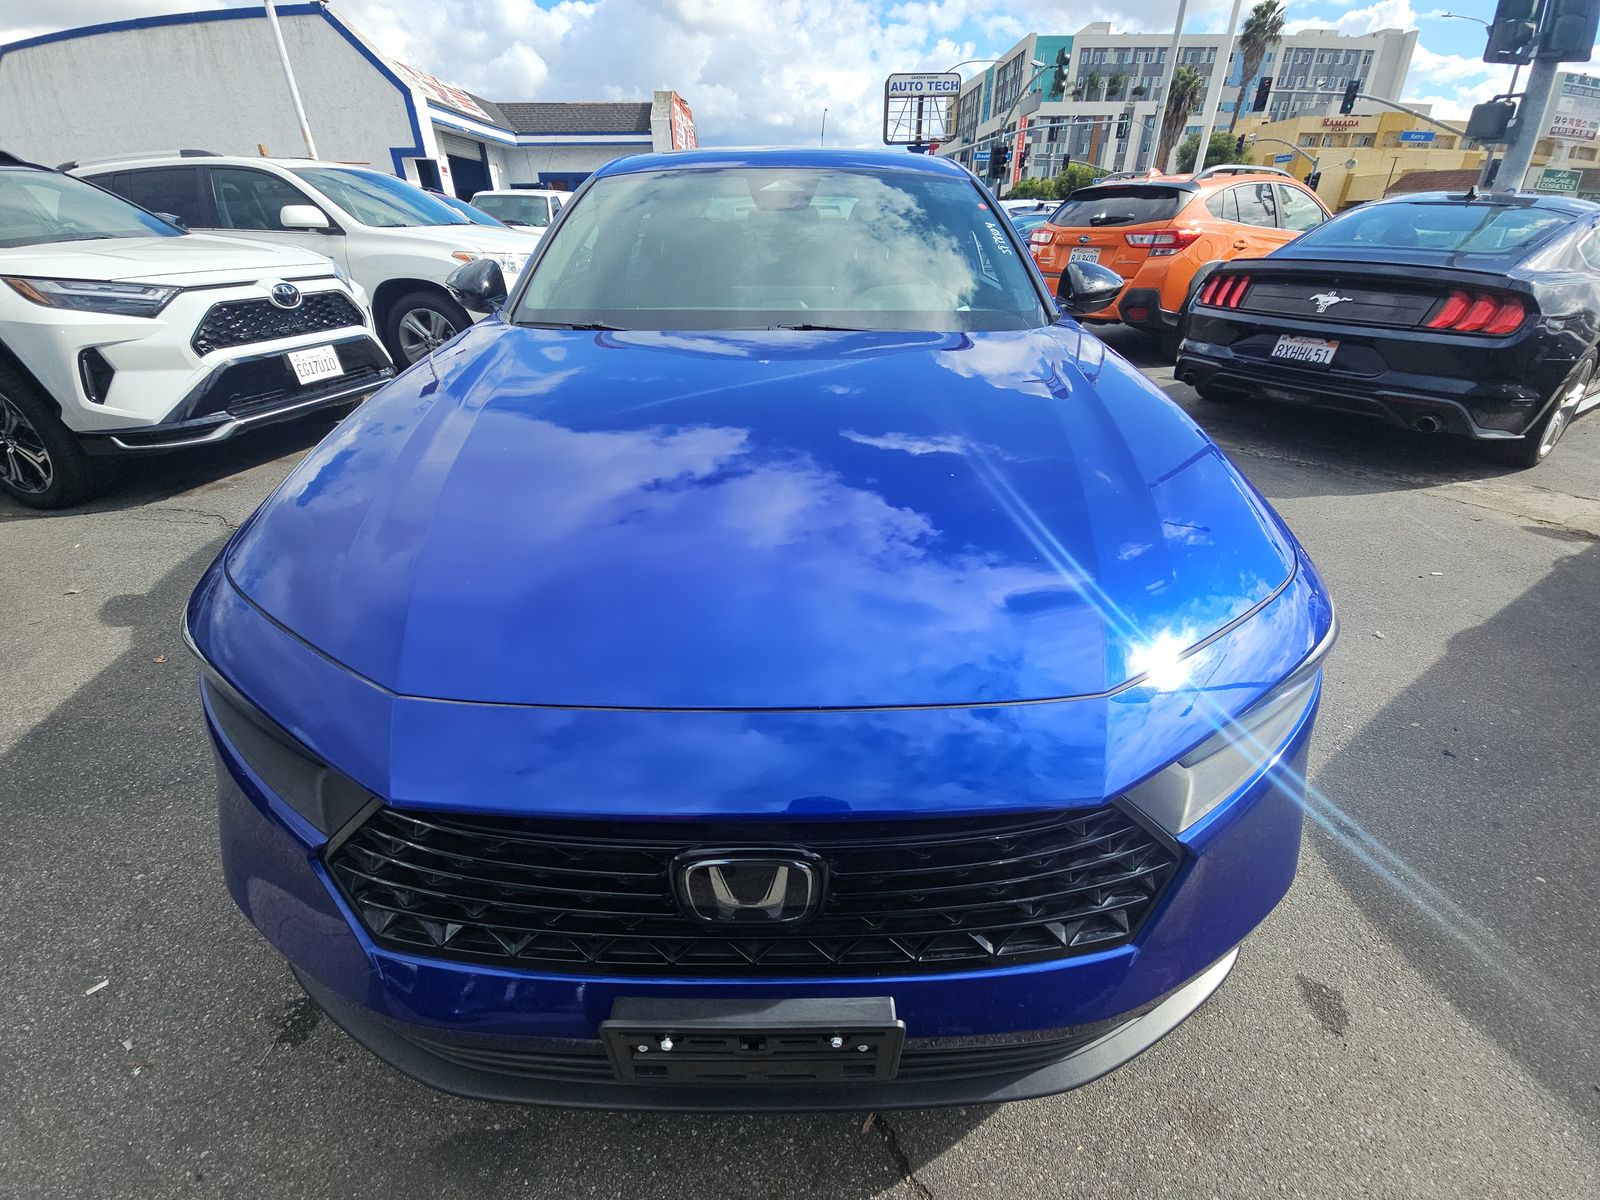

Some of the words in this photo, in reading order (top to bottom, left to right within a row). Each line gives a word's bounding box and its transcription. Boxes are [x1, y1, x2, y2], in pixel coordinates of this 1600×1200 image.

[890, 81, 923, 92] AUTO
[927, 80, 959, 91] TECH
[1540, 182, 1575, 191] COSMETICS
[1275, 344, 1330, 364] 8XHH451
